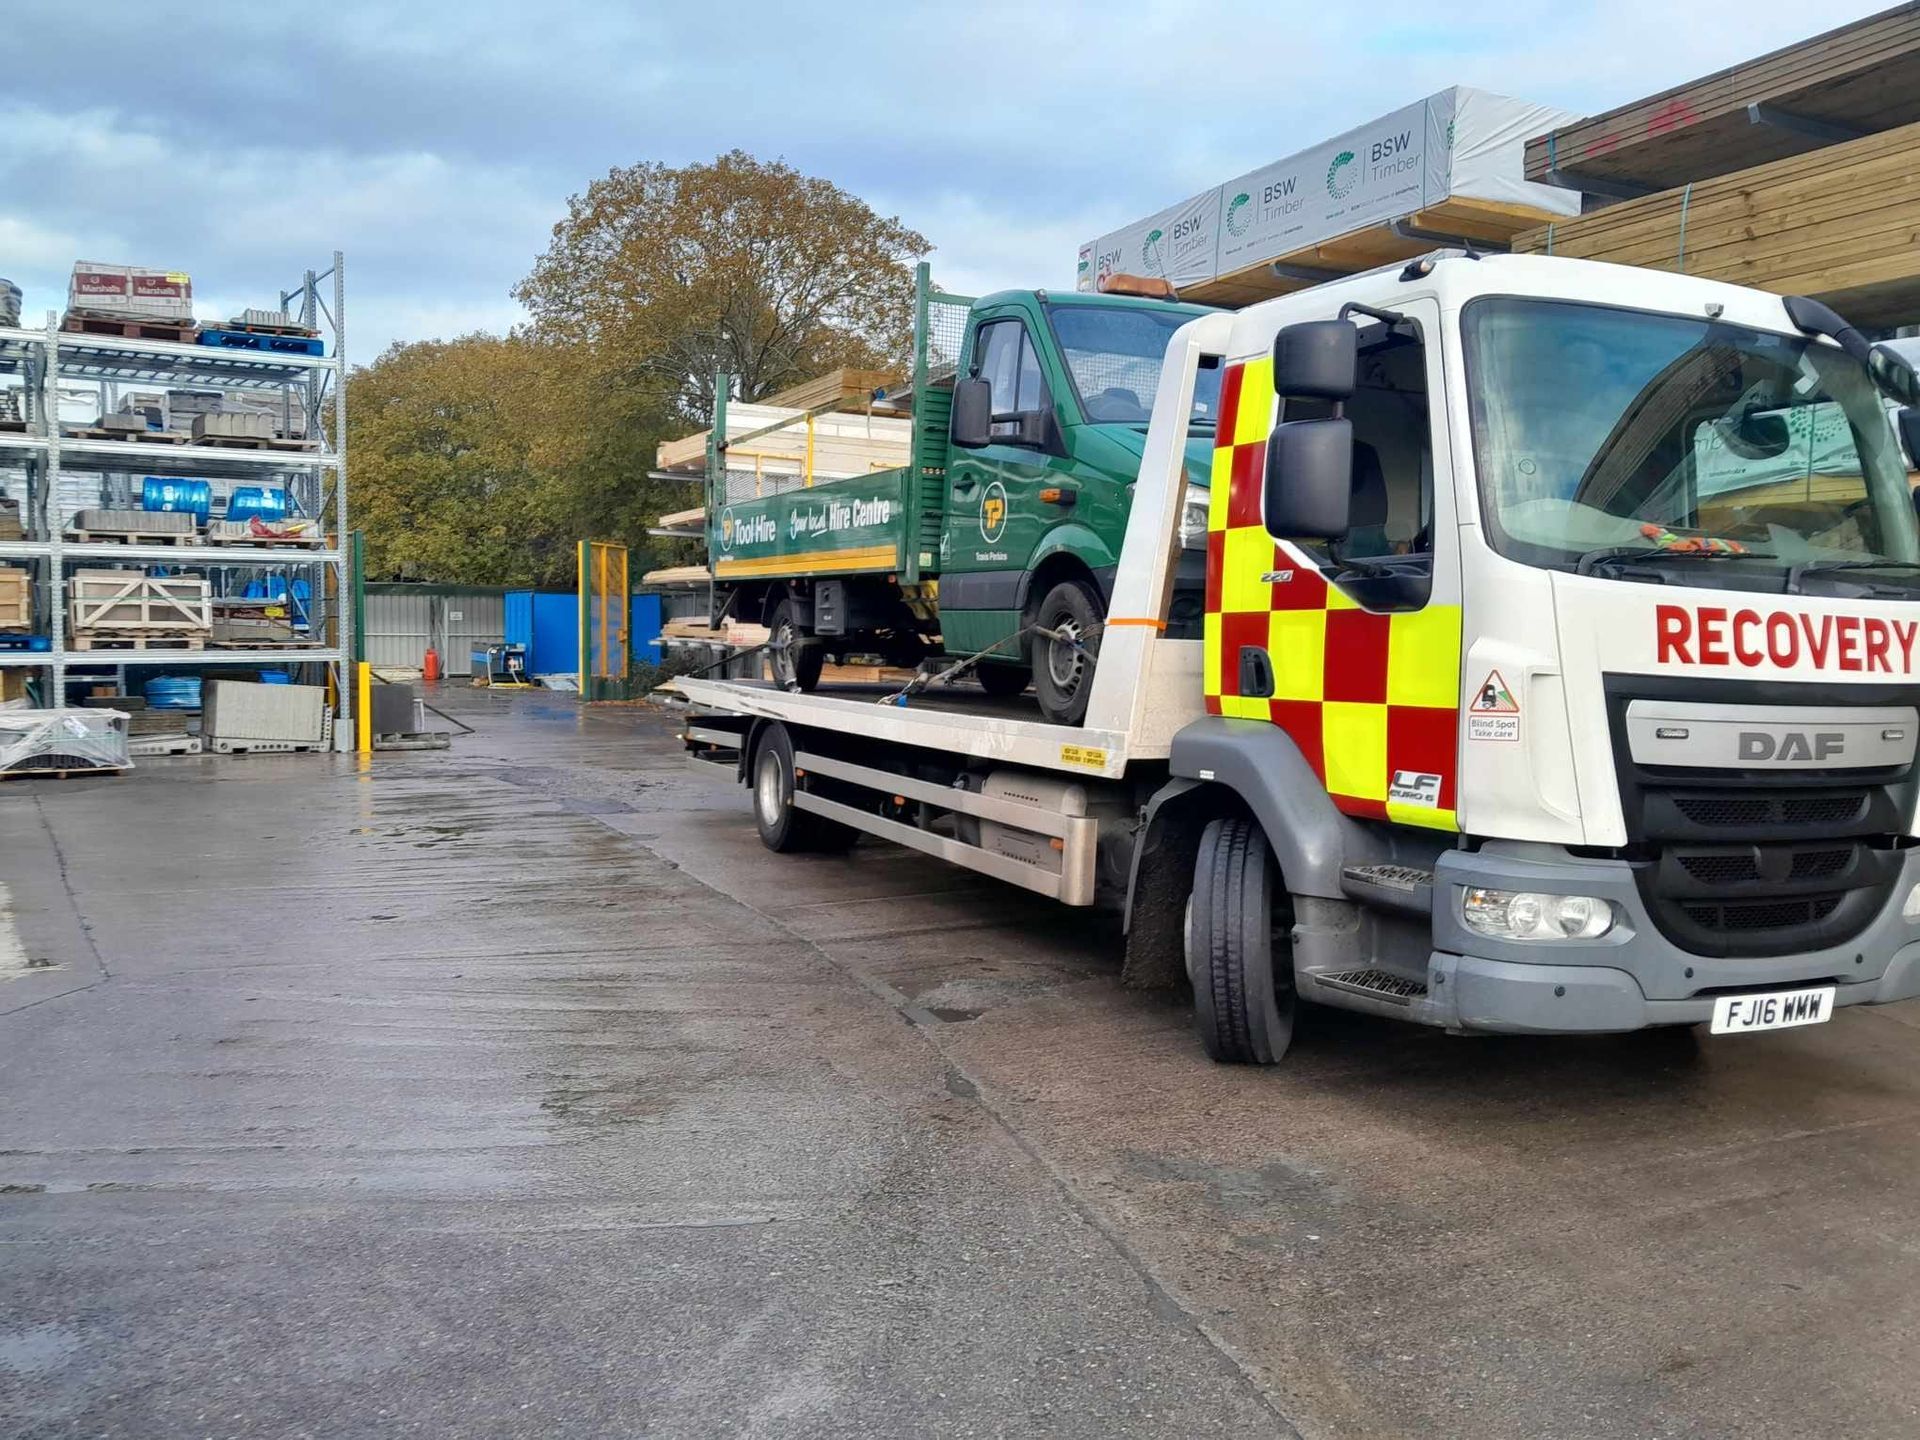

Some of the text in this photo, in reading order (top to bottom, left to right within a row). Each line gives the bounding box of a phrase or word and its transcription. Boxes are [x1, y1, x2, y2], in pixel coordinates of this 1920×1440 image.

[1371, 130, 1411, 162] BSW
[1371, 153, 1421, 181] Timber
[1264, 175, 1297, 204] BSW
[1263, 197, 1304, 221] Timber
[1173, 214, 1202, 240] BSW
[1098, 247, 1122, 271] BSW
[82, 284, 121, 293] Marshalls
[137, 286, 176, 295] Marshalls
[829, 502, 850, 531] Hire
[852, 496, 890, 528] Centre
[984, 499, 1004, 529] TP
[735, 514, 776, 545] Tool Hire
[1261, 572, 1292, 582] 220
[1656, 604, 1919, 674] RECOVERY
[1471, 719, 1516, 729] Blind Spot
[1474, 729, 1492, 737] Take
[1738, 732, 1845, 761] DAF
[1393, 772, 1439, 790] LF
[1727, 999, 1777, 1028] FJ16
